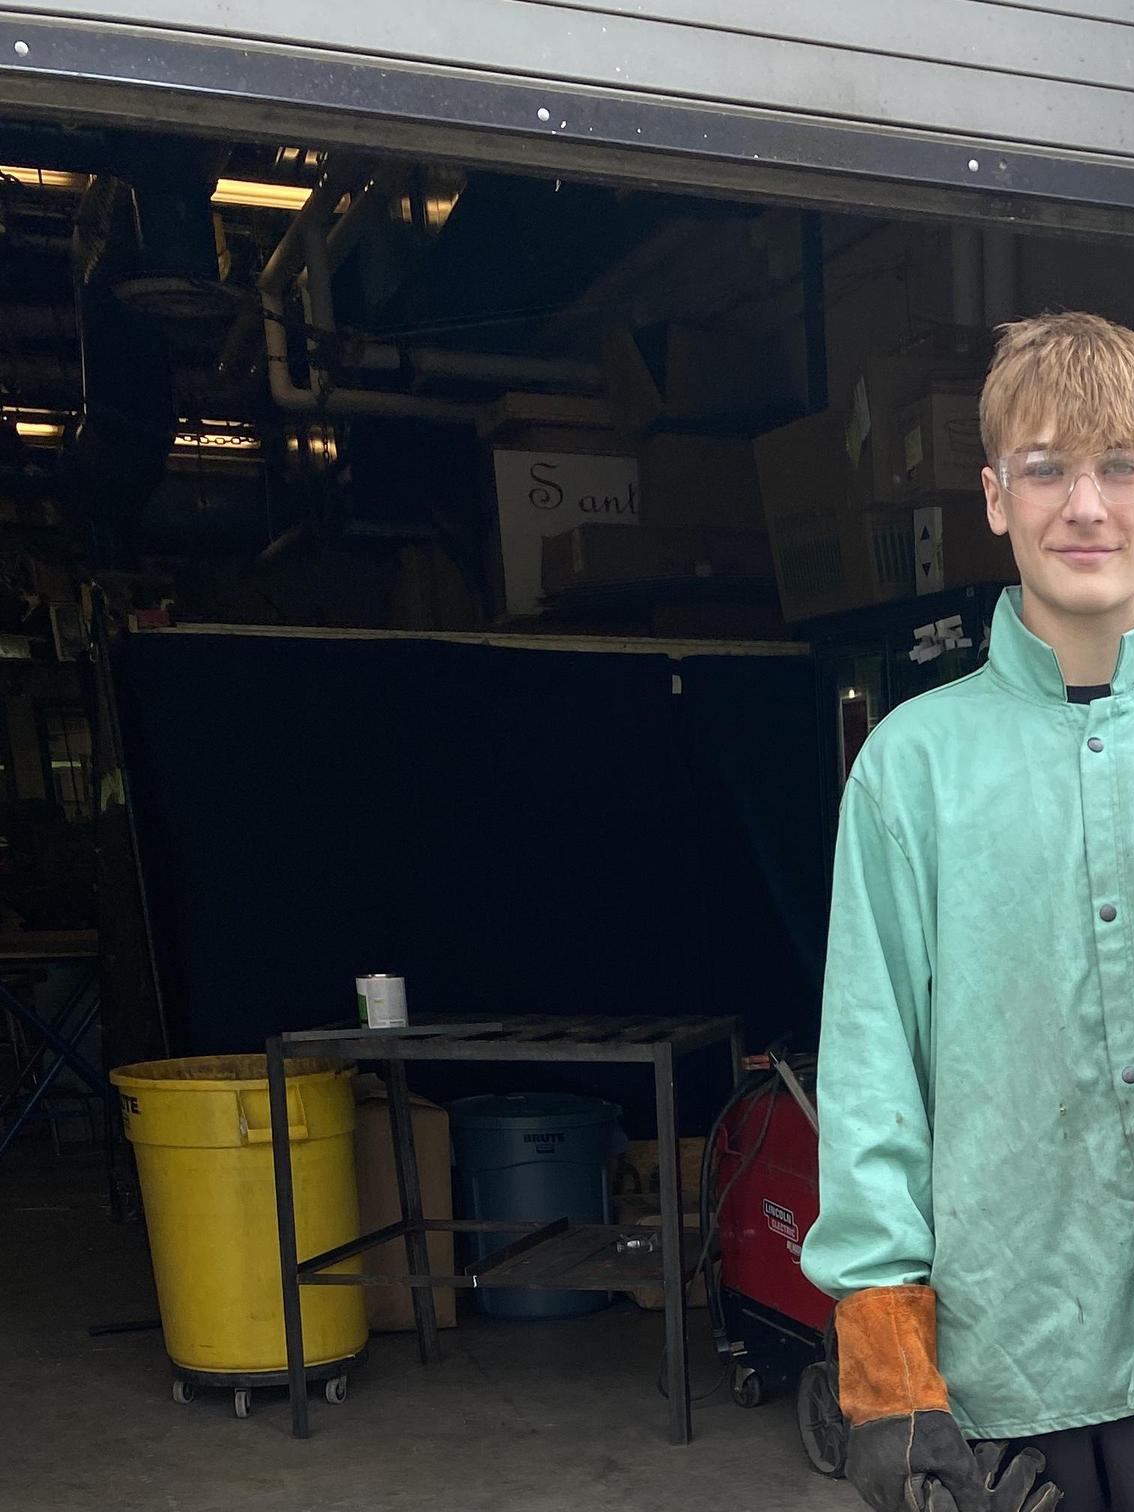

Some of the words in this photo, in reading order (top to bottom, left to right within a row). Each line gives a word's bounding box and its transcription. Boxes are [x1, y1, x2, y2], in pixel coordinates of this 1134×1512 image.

[523, 1132, 565, 1143] BRUTE
[766, 1203, 792, 1225] LINCOLN
[772, 1219, 796, 1237] ELECTRIC
